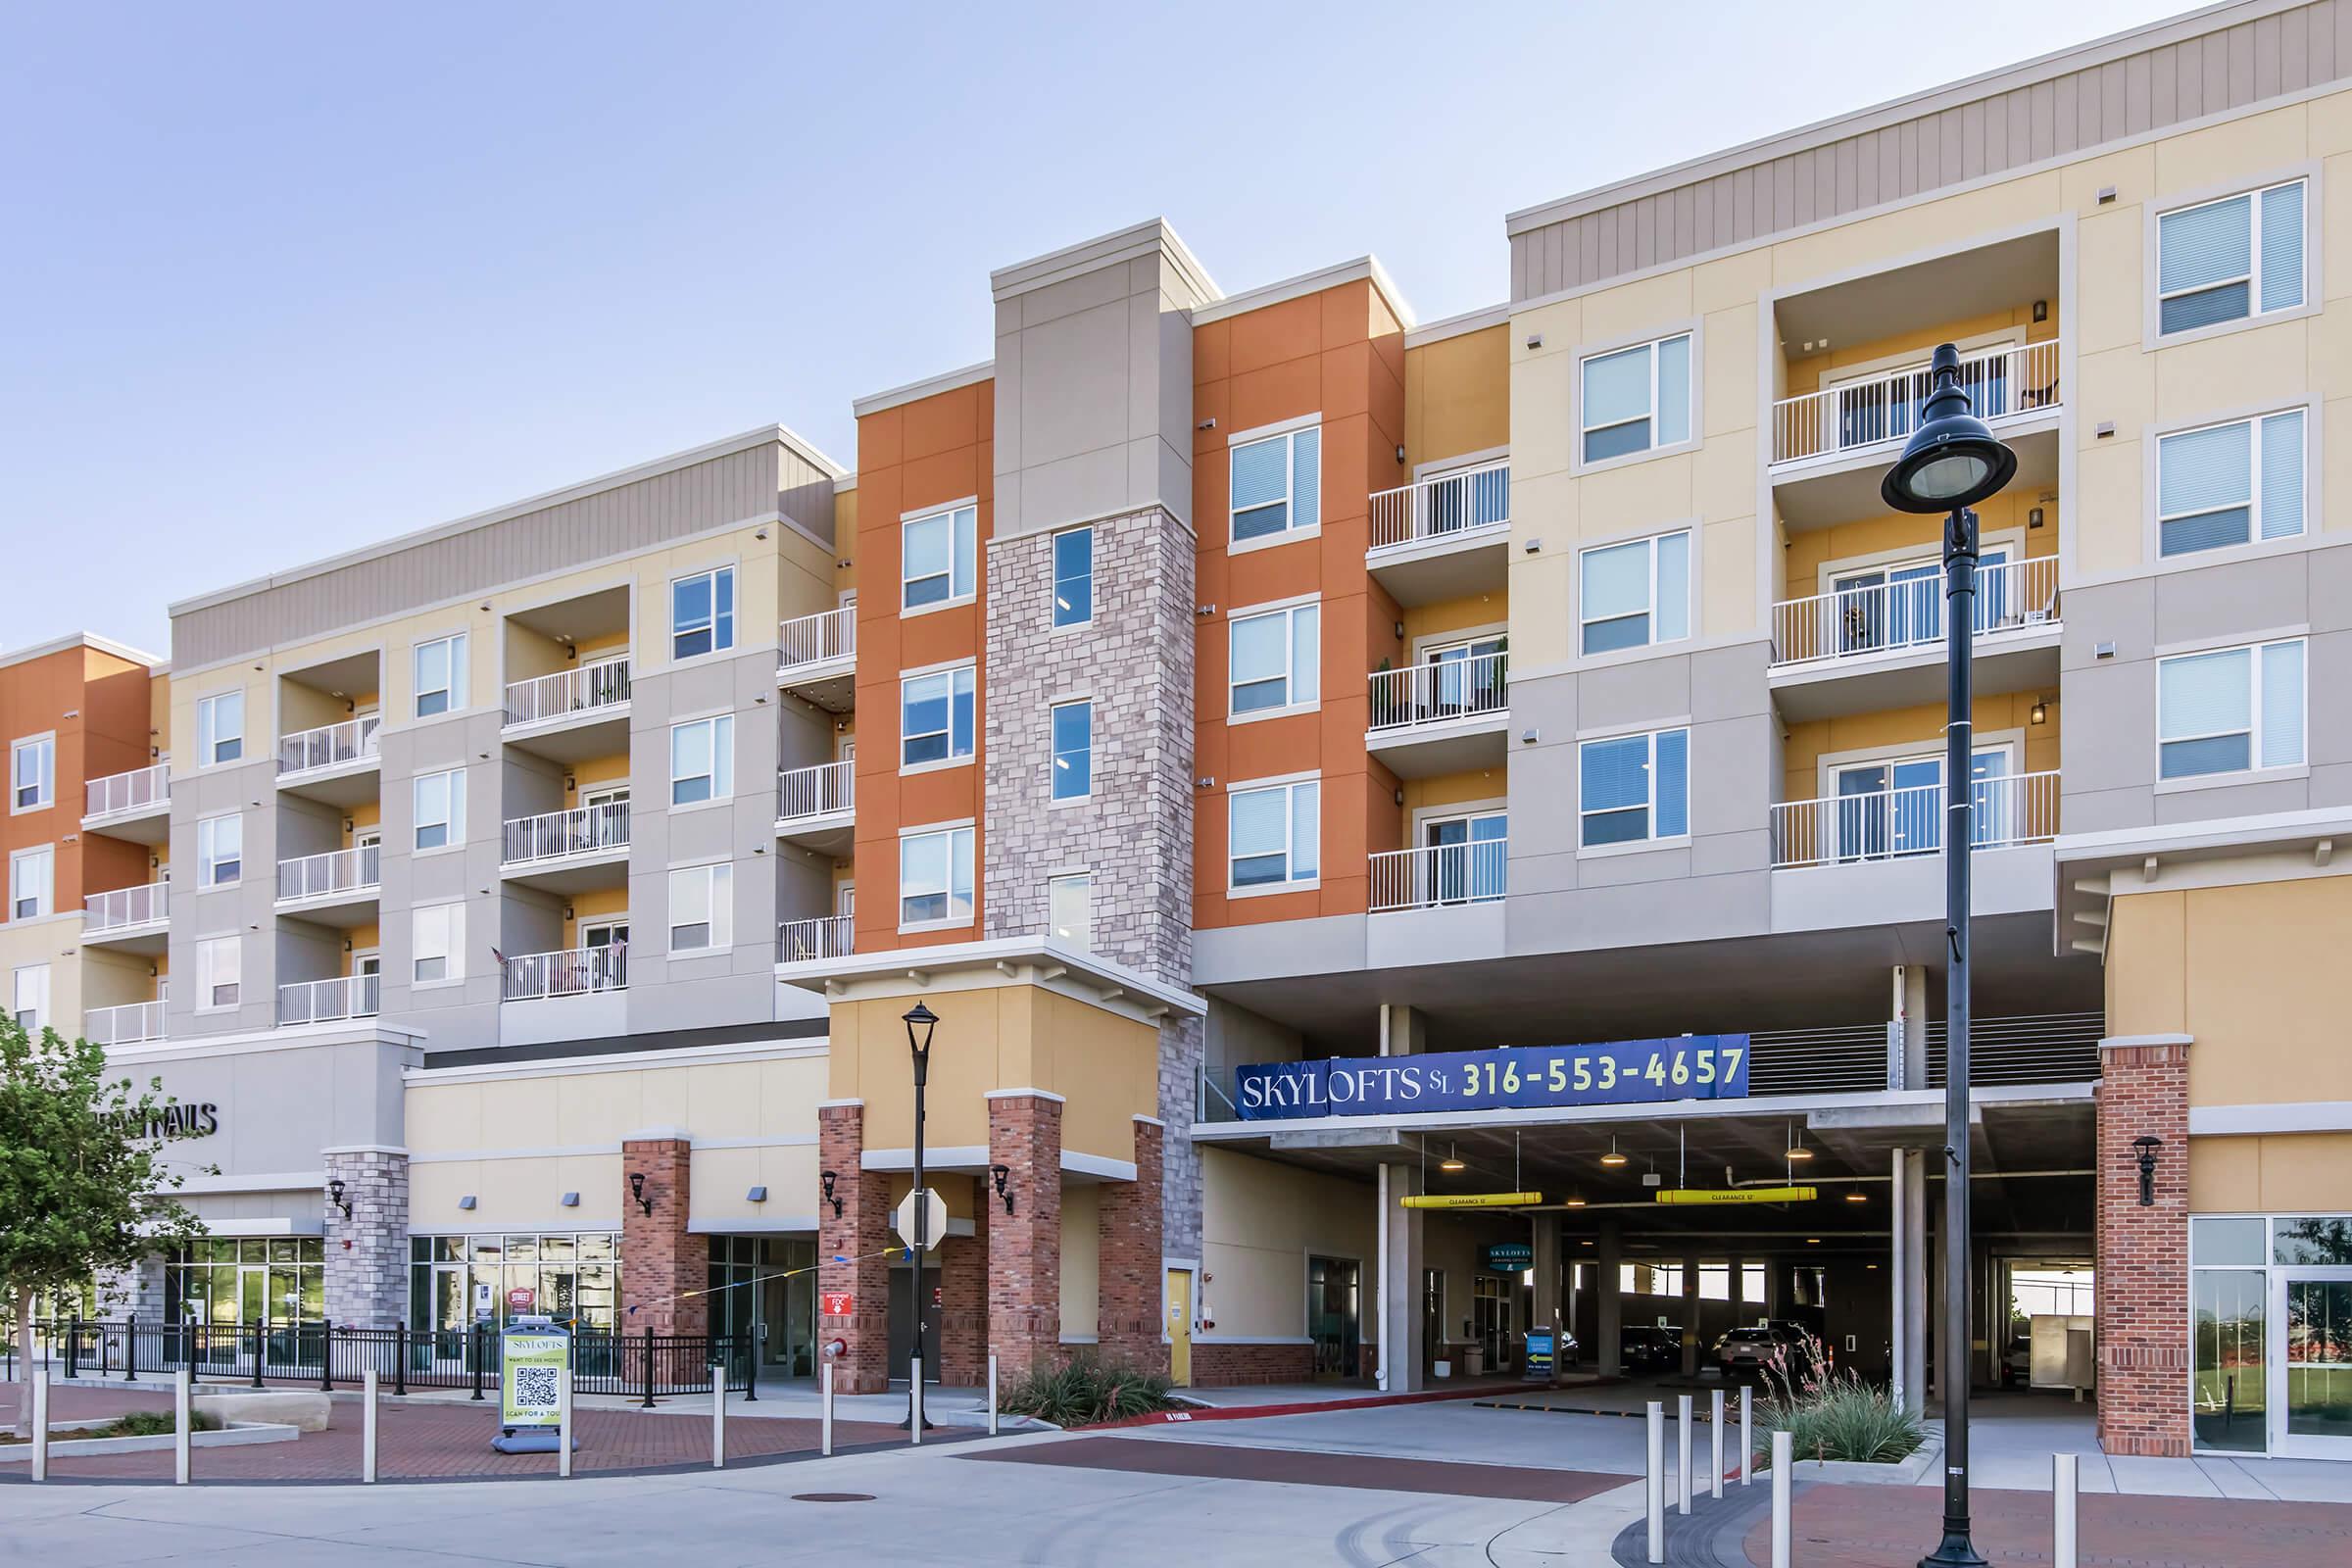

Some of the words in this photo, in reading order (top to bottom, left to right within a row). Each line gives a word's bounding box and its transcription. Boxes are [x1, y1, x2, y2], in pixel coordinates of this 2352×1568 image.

[1243, 1067, 1422, 1107] SKYLOFTS
[1429, 1069, 1454, 1095] SL
[1463, 1049, 1743, 1097] 316-553-4657
[142, 1103, 218, 1138] NAILS
[513, 1341, 564, 1349] SKYLOFTS
